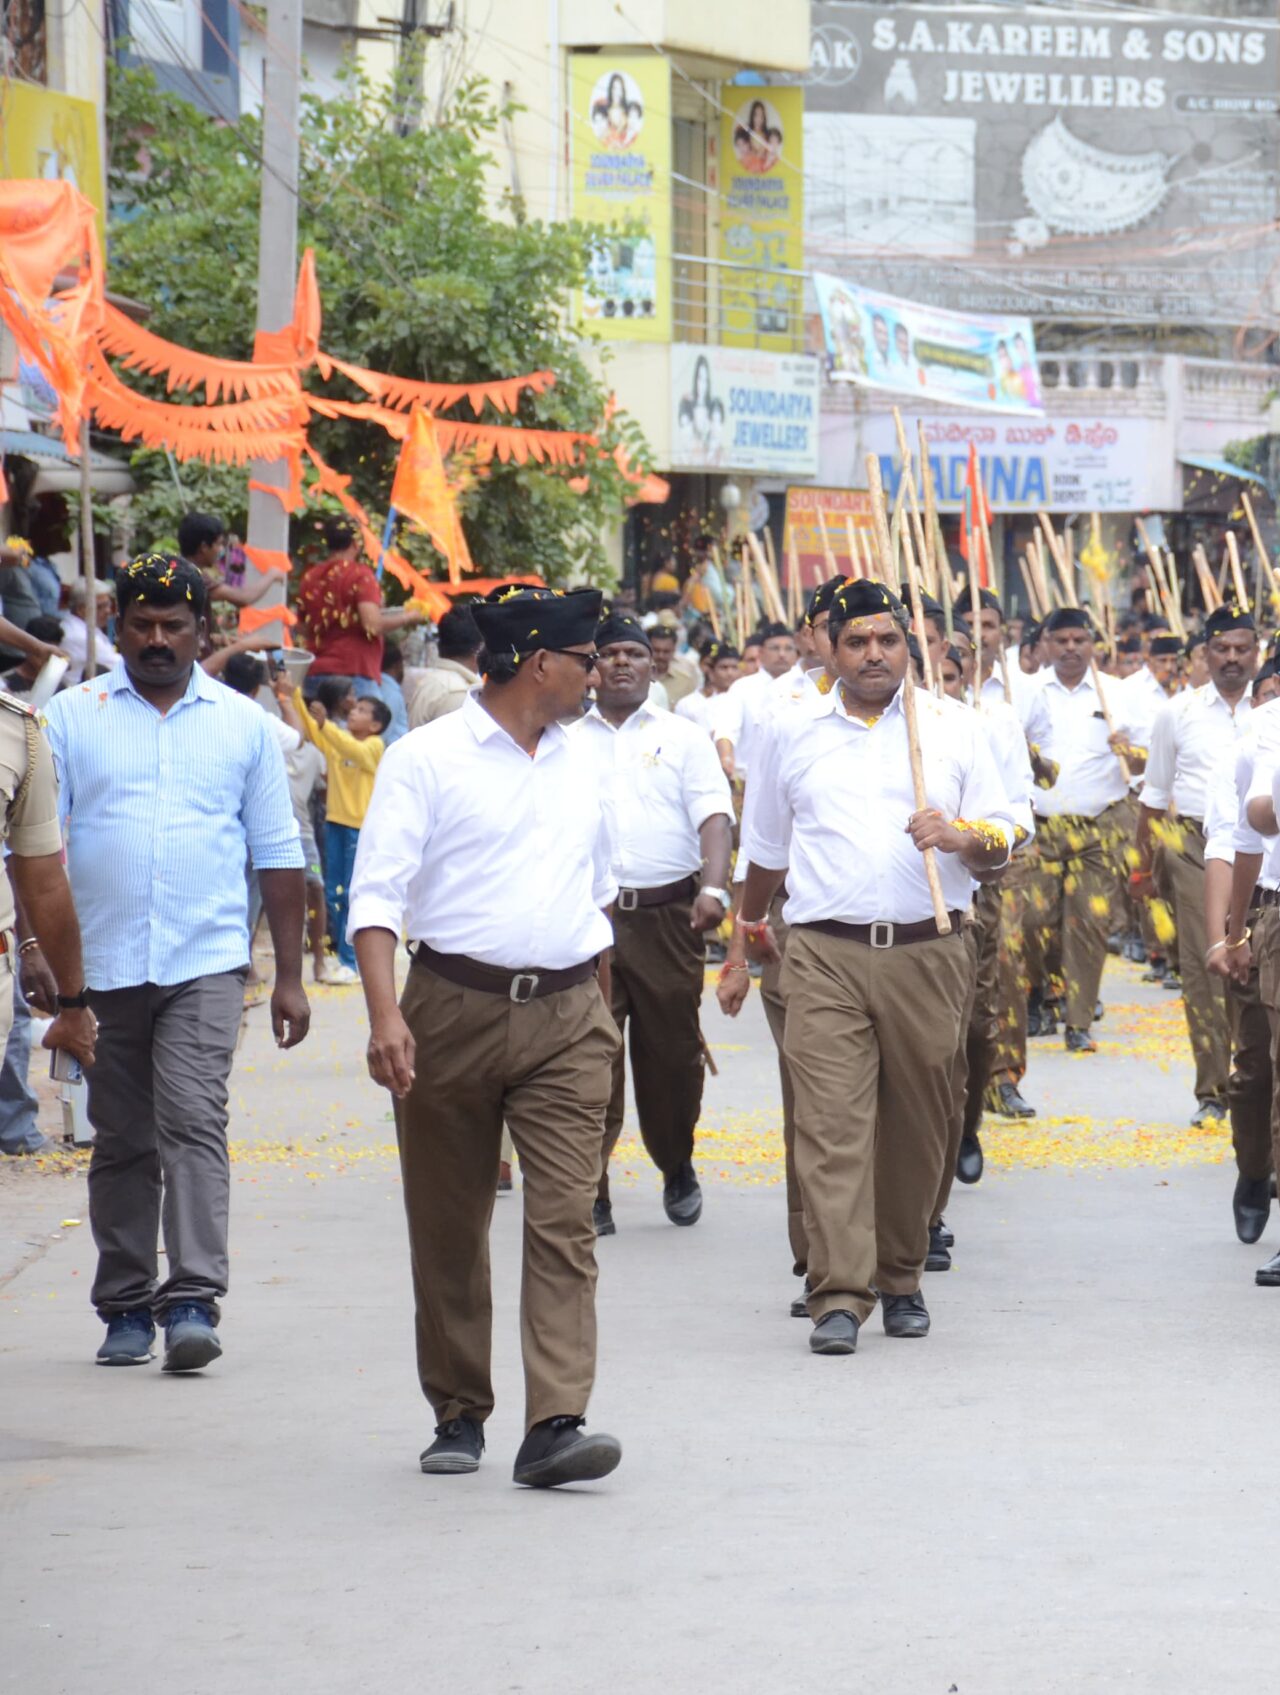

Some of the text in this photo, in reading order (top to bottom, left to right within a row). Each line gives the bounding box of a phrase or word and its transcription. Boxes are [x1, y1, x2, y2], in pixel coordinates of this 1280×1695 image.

[872, 18, 1266, 65] S.A.KAREEM & SONS
[943, 71, 1167, 109] JEWELLERS
[729, 387, 813, 419] SOUNDARYA
[733, 420, 808, 451] JEWELLERS
